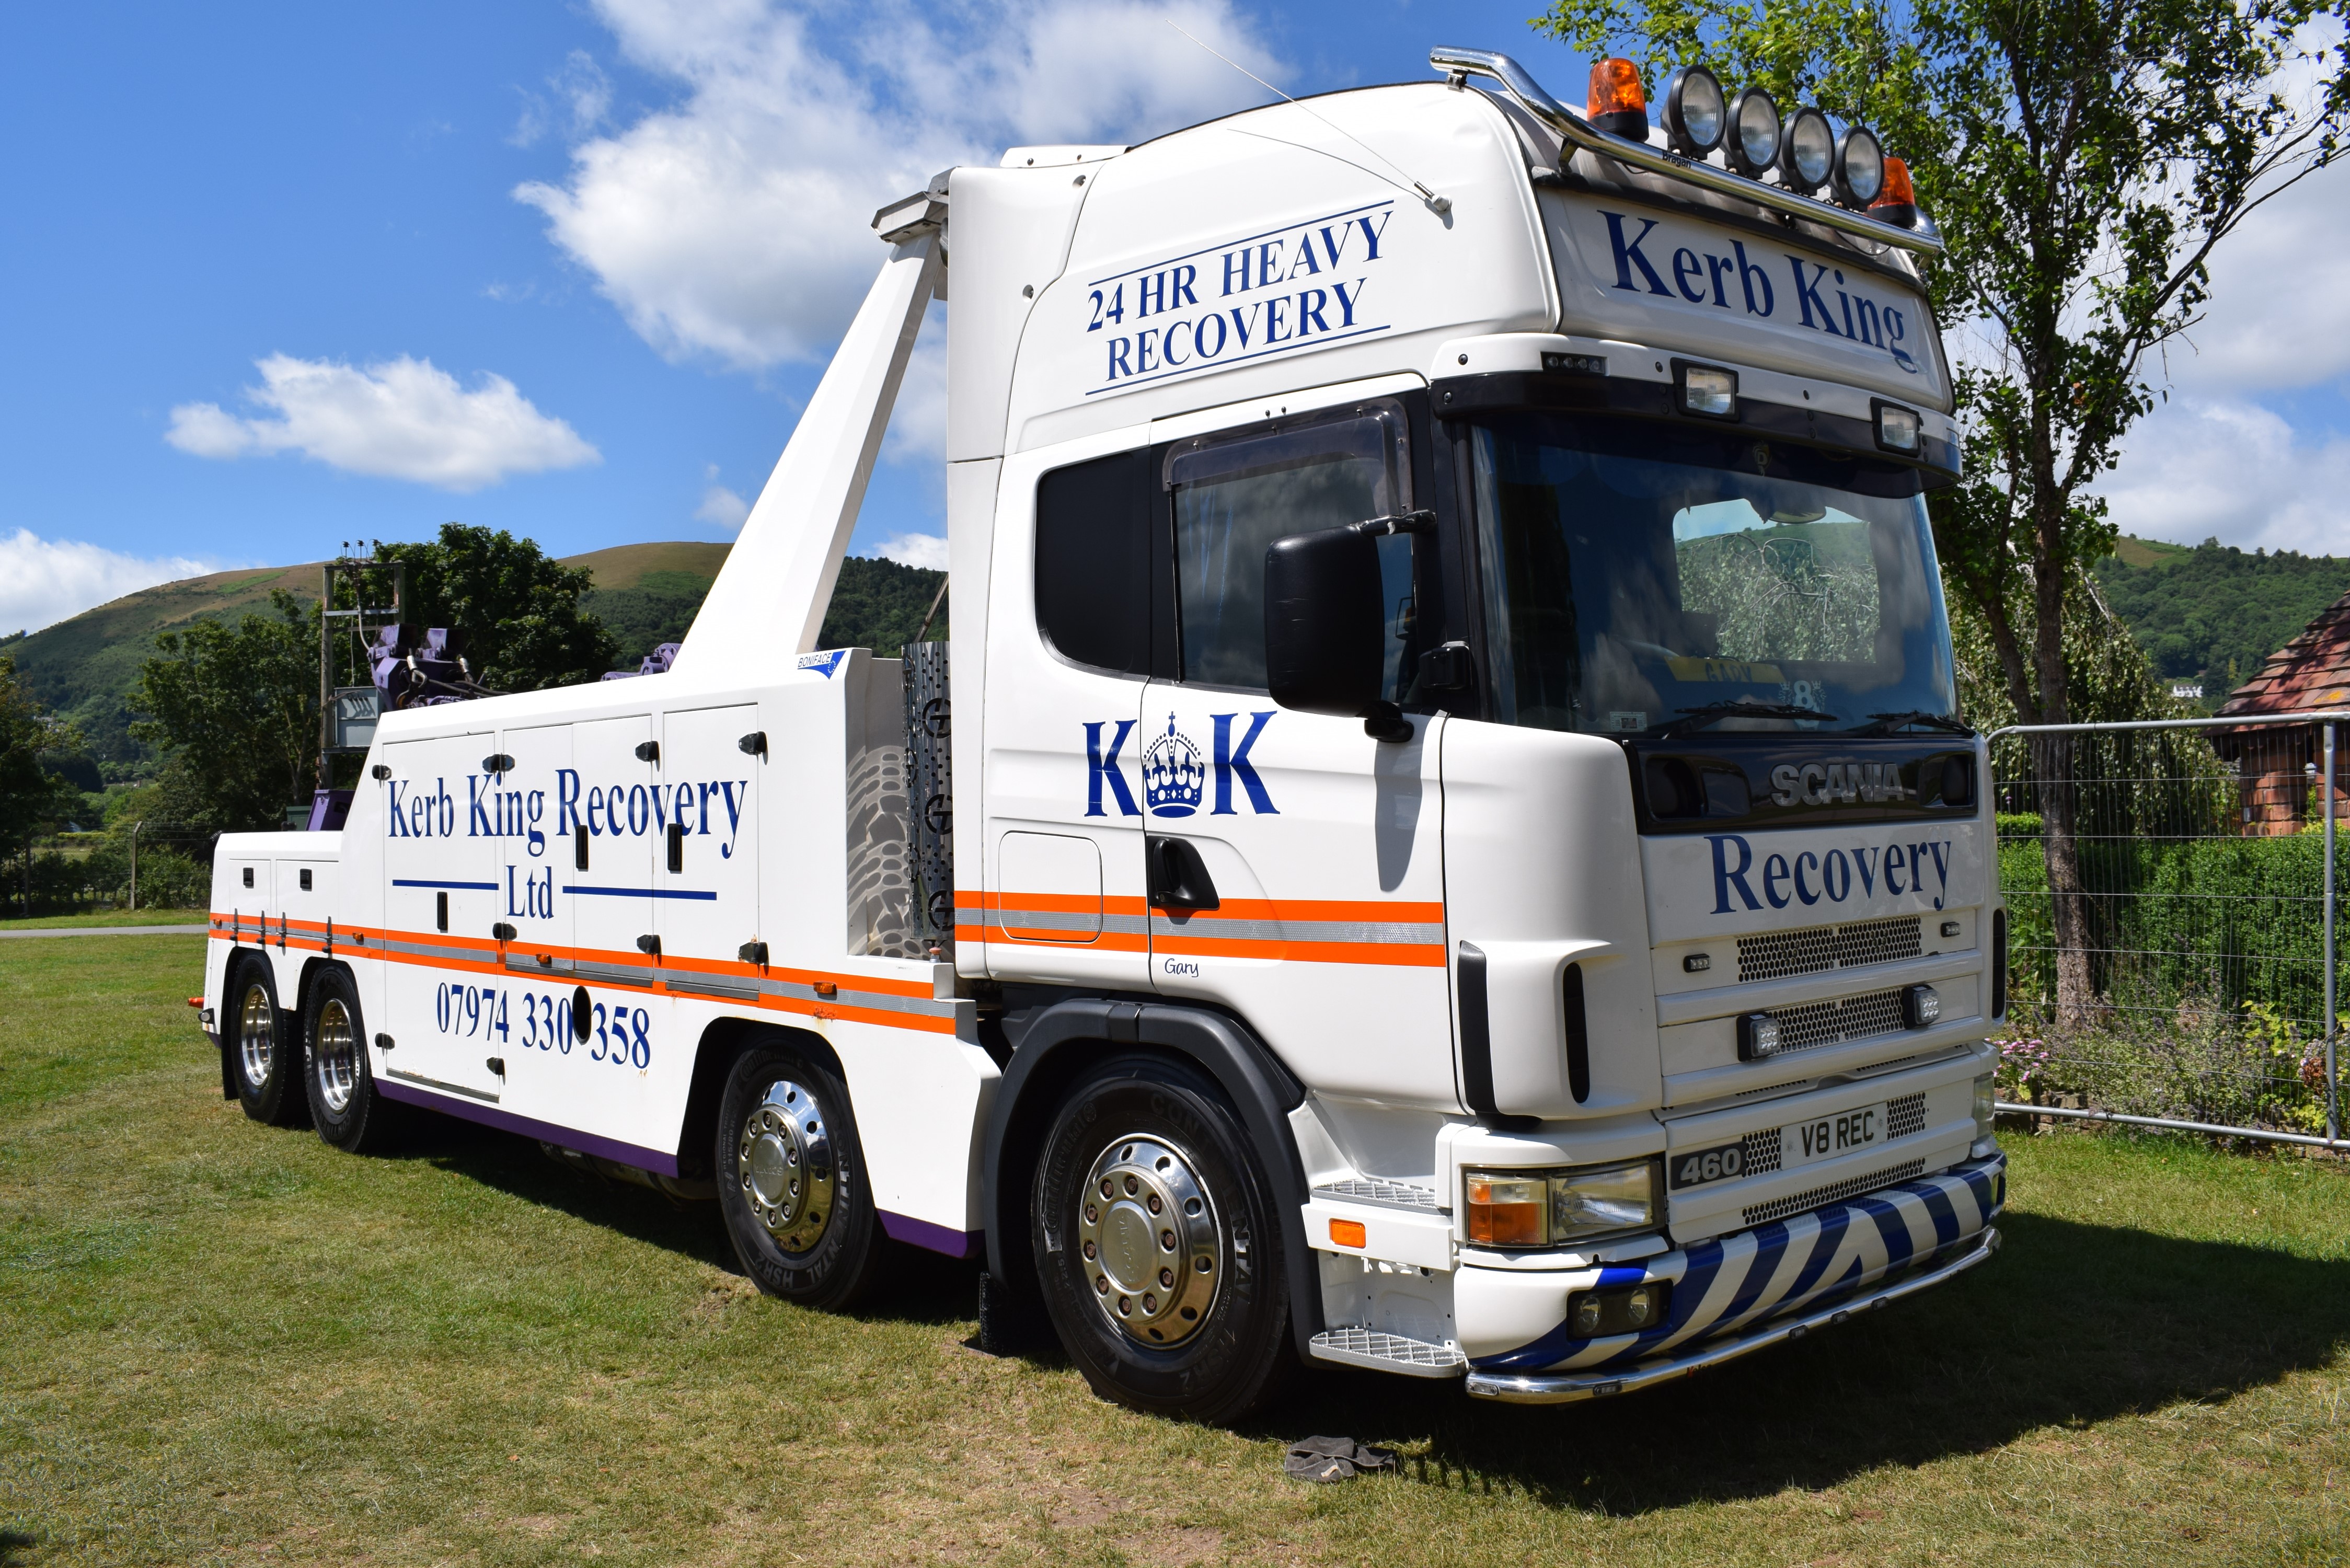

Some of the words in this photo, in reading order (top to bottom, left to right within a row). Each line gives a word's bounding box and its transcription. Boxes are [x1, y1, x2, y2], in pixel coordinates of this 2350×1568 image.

[1662, 151, 1691, 169] Bragan
[1087, 283, 1124, 332] 24
[1136, 264, 1199, 319] HR
[1219, 211, 1394, 298] HEAVY
[1597, 210, 1774, 317] Kerb
[1784, 254, 1917, 374] King
[1105, 277, 1367, 382] RECOVERY
[798, 652, 832, 668] BONIFACE
[1082, 719, 1144, 817] K
[1209, 711, 1281, 815] K
[1770, 763, 1905, 807] SCANIA
[388, 777, 455, 837] Kerb
[466, 773, 545, 857] King
[555, 768, 748, 859] Recovery
[506, 865, 554, 919] Ltd
[1703, 834, 1951, 915] Recovery
[1164, 958, 1199, 977] Gary
[436, 982, 510, 1043] 07974
[522, 992, 574, 1055] 330
[591, 1002, 651, 1069] 358
[1679, 1148, 1742, 1183] 460
[1801, 1122, 1830, 1157] V8
[1836, 1110, 1874, 1150] REC
